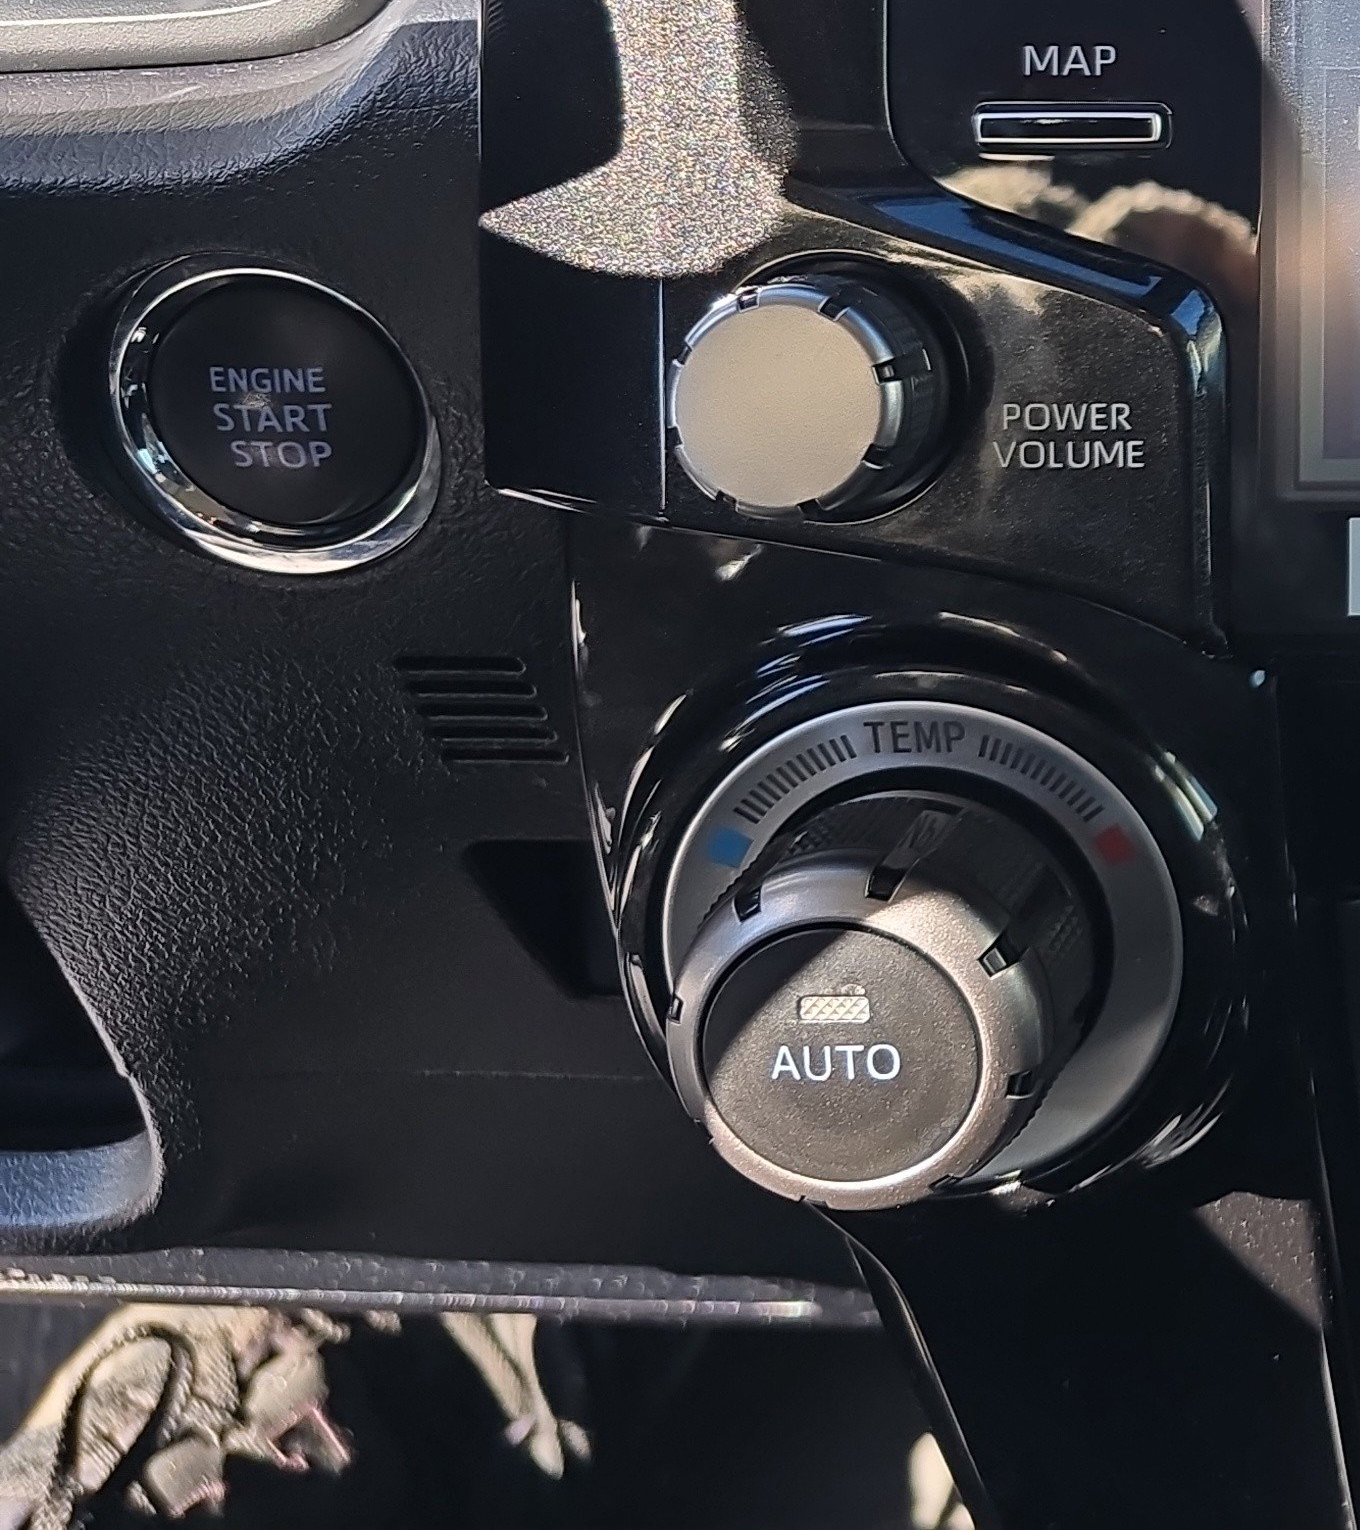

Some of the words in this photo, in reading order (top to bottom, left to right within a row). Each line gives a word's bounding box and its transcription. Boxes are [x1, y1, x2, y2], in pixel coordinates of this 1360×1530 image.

[1022, 45, 1117, 76] MAP
[209, 366, 327, 394] ENGINE
[213, 402, 333, 433] START
[1002, 402, 1132, 431] POWER
[230, 440, 333, 468] STOP
[993, 440, 1146, 469] VOLUME
[862, 720, 966, 755] TEMP
[770, 1043, 902, 1083] AUTO
